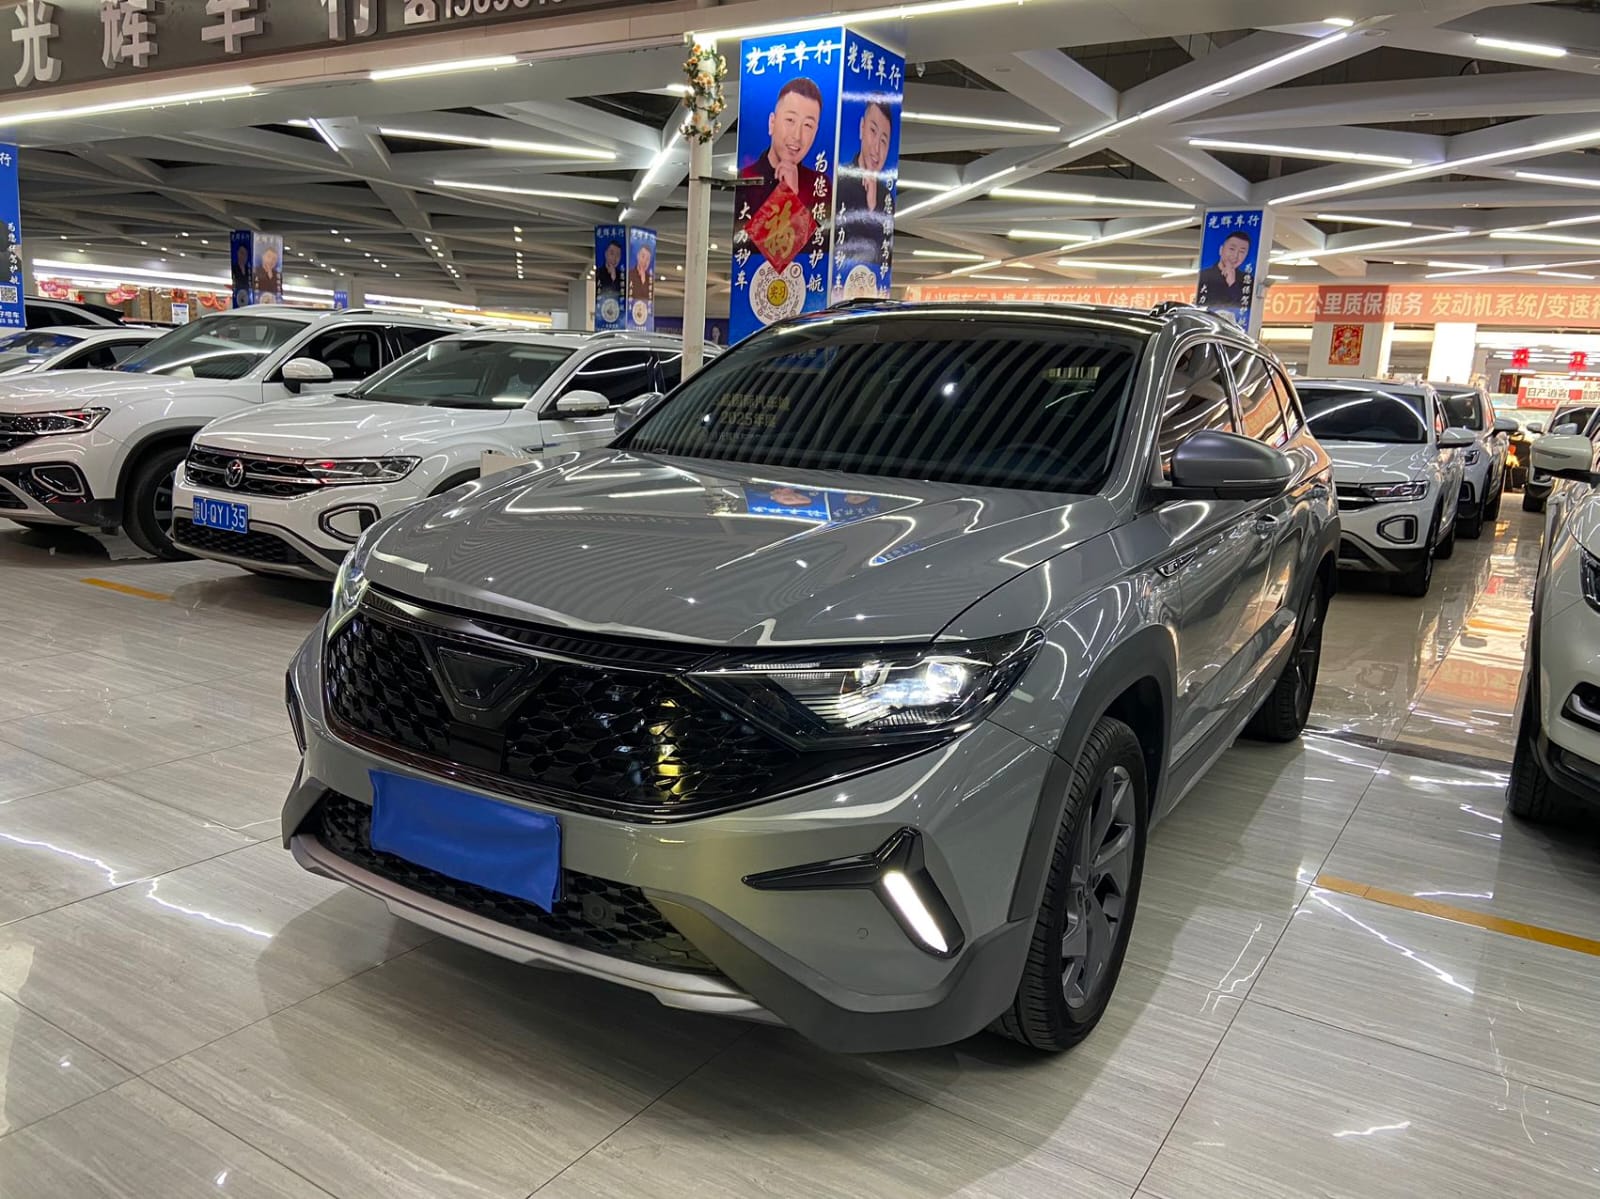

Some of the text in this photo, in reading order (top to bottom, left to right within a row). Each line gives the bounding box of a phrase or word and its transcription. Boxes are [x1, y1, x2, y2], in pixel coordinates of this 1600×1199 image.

[745, 39, 833, 75] 光辉车行
[847, 41, 902, 91] 光辉车行
[734, 202, 752, 291] 大力秒车
[763, 200, 796, 260] 福
[807, 150, 829, 293] 为您保驾护航
[834, 202, 847, 289] 大力秒车
[1208, 214, 1260, 229] 光辉车行
[769, 285, 786, 301] 实习
